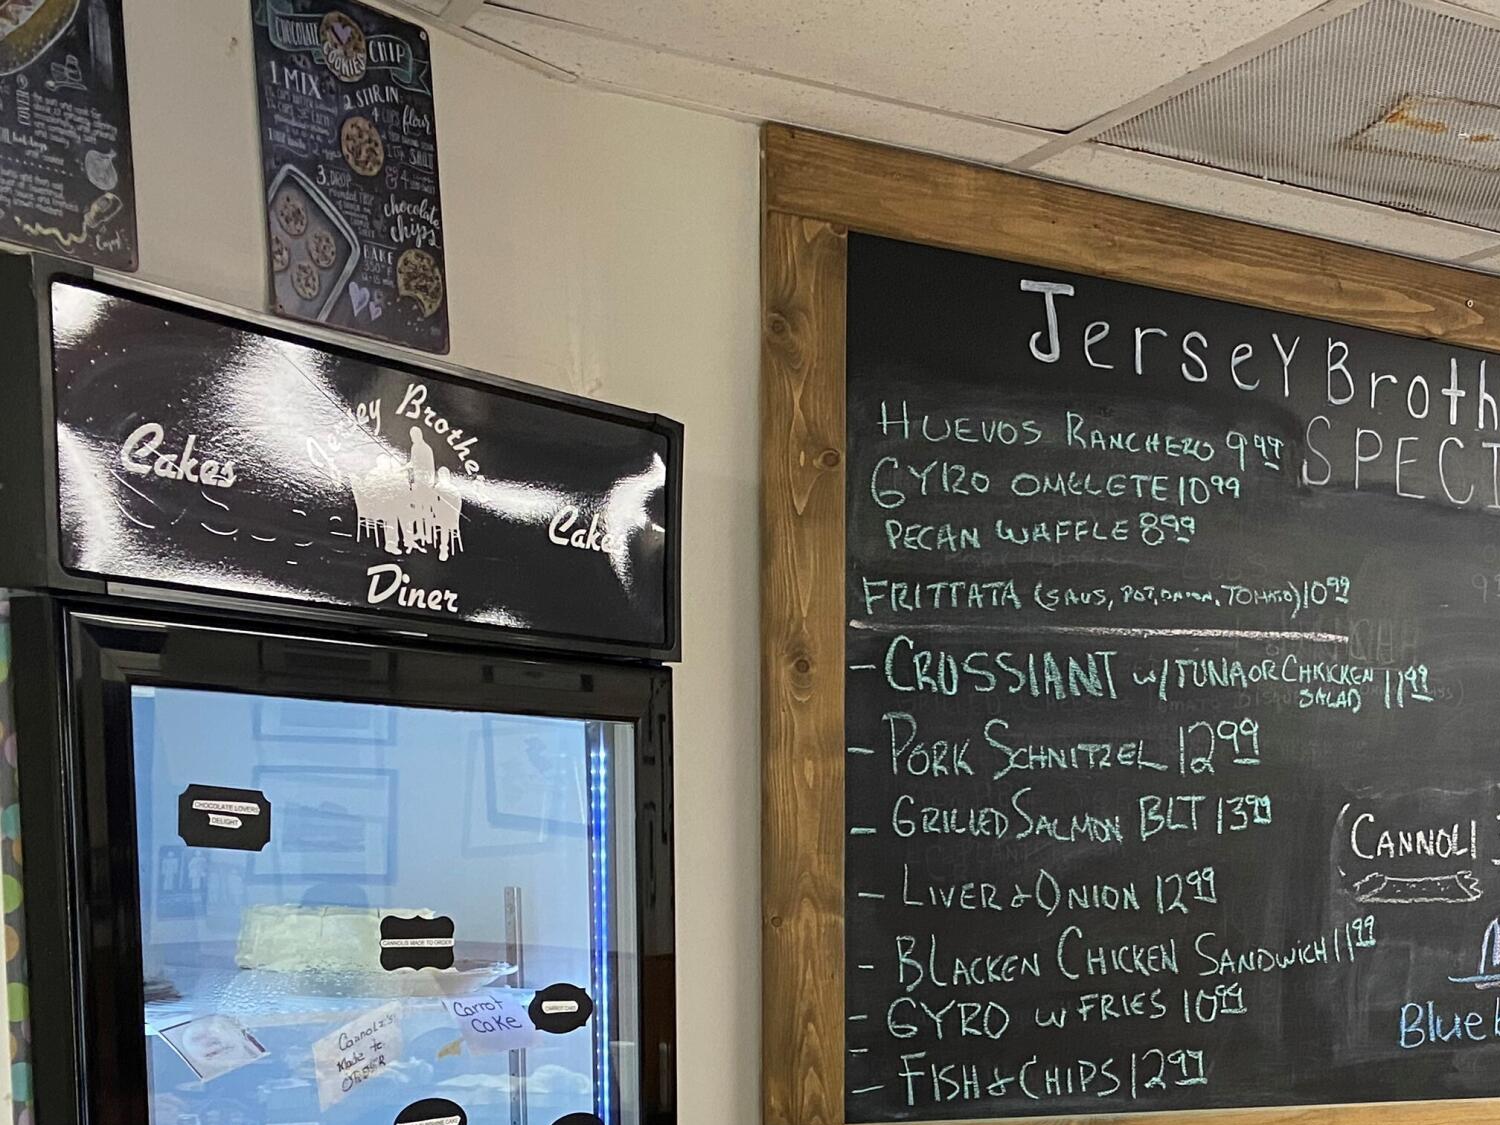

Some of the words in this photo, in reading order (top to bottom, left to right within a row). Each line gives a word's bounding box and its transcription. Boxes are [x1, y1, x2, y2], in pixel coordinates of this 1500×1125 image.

[323, 41, 366, 77] COOKIES
[369, 41, 405, 63] CHIP
[284, 67, 322, 100] MIX
[402, 104, 432, 135] flour
[384, 193, 441, 230] chocolate
[391, 214, 442, 248] chips
[363, 244, 394, 266] BAKE
[1019, 279, 1300, 398] Jersey
[877, 400, 1042, 444] HUEVOS
[1066, 411, 1214, 462] RANCHERO
[121, 423, 236, 487] Cakes
[870, 456, 990, 508] GYRO
[548, 505, 622, 554] Cake
[885, 519, 981, 551] PECAN
[996, 518, 1129, 545] WAFFLE
[366, 563, 459, 614] Diner
[862, 576, 1022, 615] FRITTATA
[1175, 657, 1249, 689] TUNA
[1248, 659, 1280, 683] OR
[1299, 687, 1362, 713] SALAD
[882, 712, 975, 778] PORK
[984, 718, 1169, 780] SCHNITZEL
[194, 802, 233, 811] CHOCOLATE
[211, 816, 239, 826] DELIGHT
[1015, 787, 1124, 846] SALMON
[1139, 794, 1206, 842] BLT
[902, 862, 1003, 912] LIVER
[1035, 868, 1140, 918] ONION
[896, 934, 1040, 993] BLACKEN
[1056, 926, 1180, 978] CHICKEN
[1194, 932, 1328, 978] SANDWICH
[453, 997, 503, 1018] Carrot
[471, 1017, 523, 1034] Cake
[886, 998, 1010, 1040] GYRO
[1077, 988, 1167, 1022] FRIES
[898, 1051, 980, 1107] FISH
[1018, 1055, 1122, 1101] CHIPS
